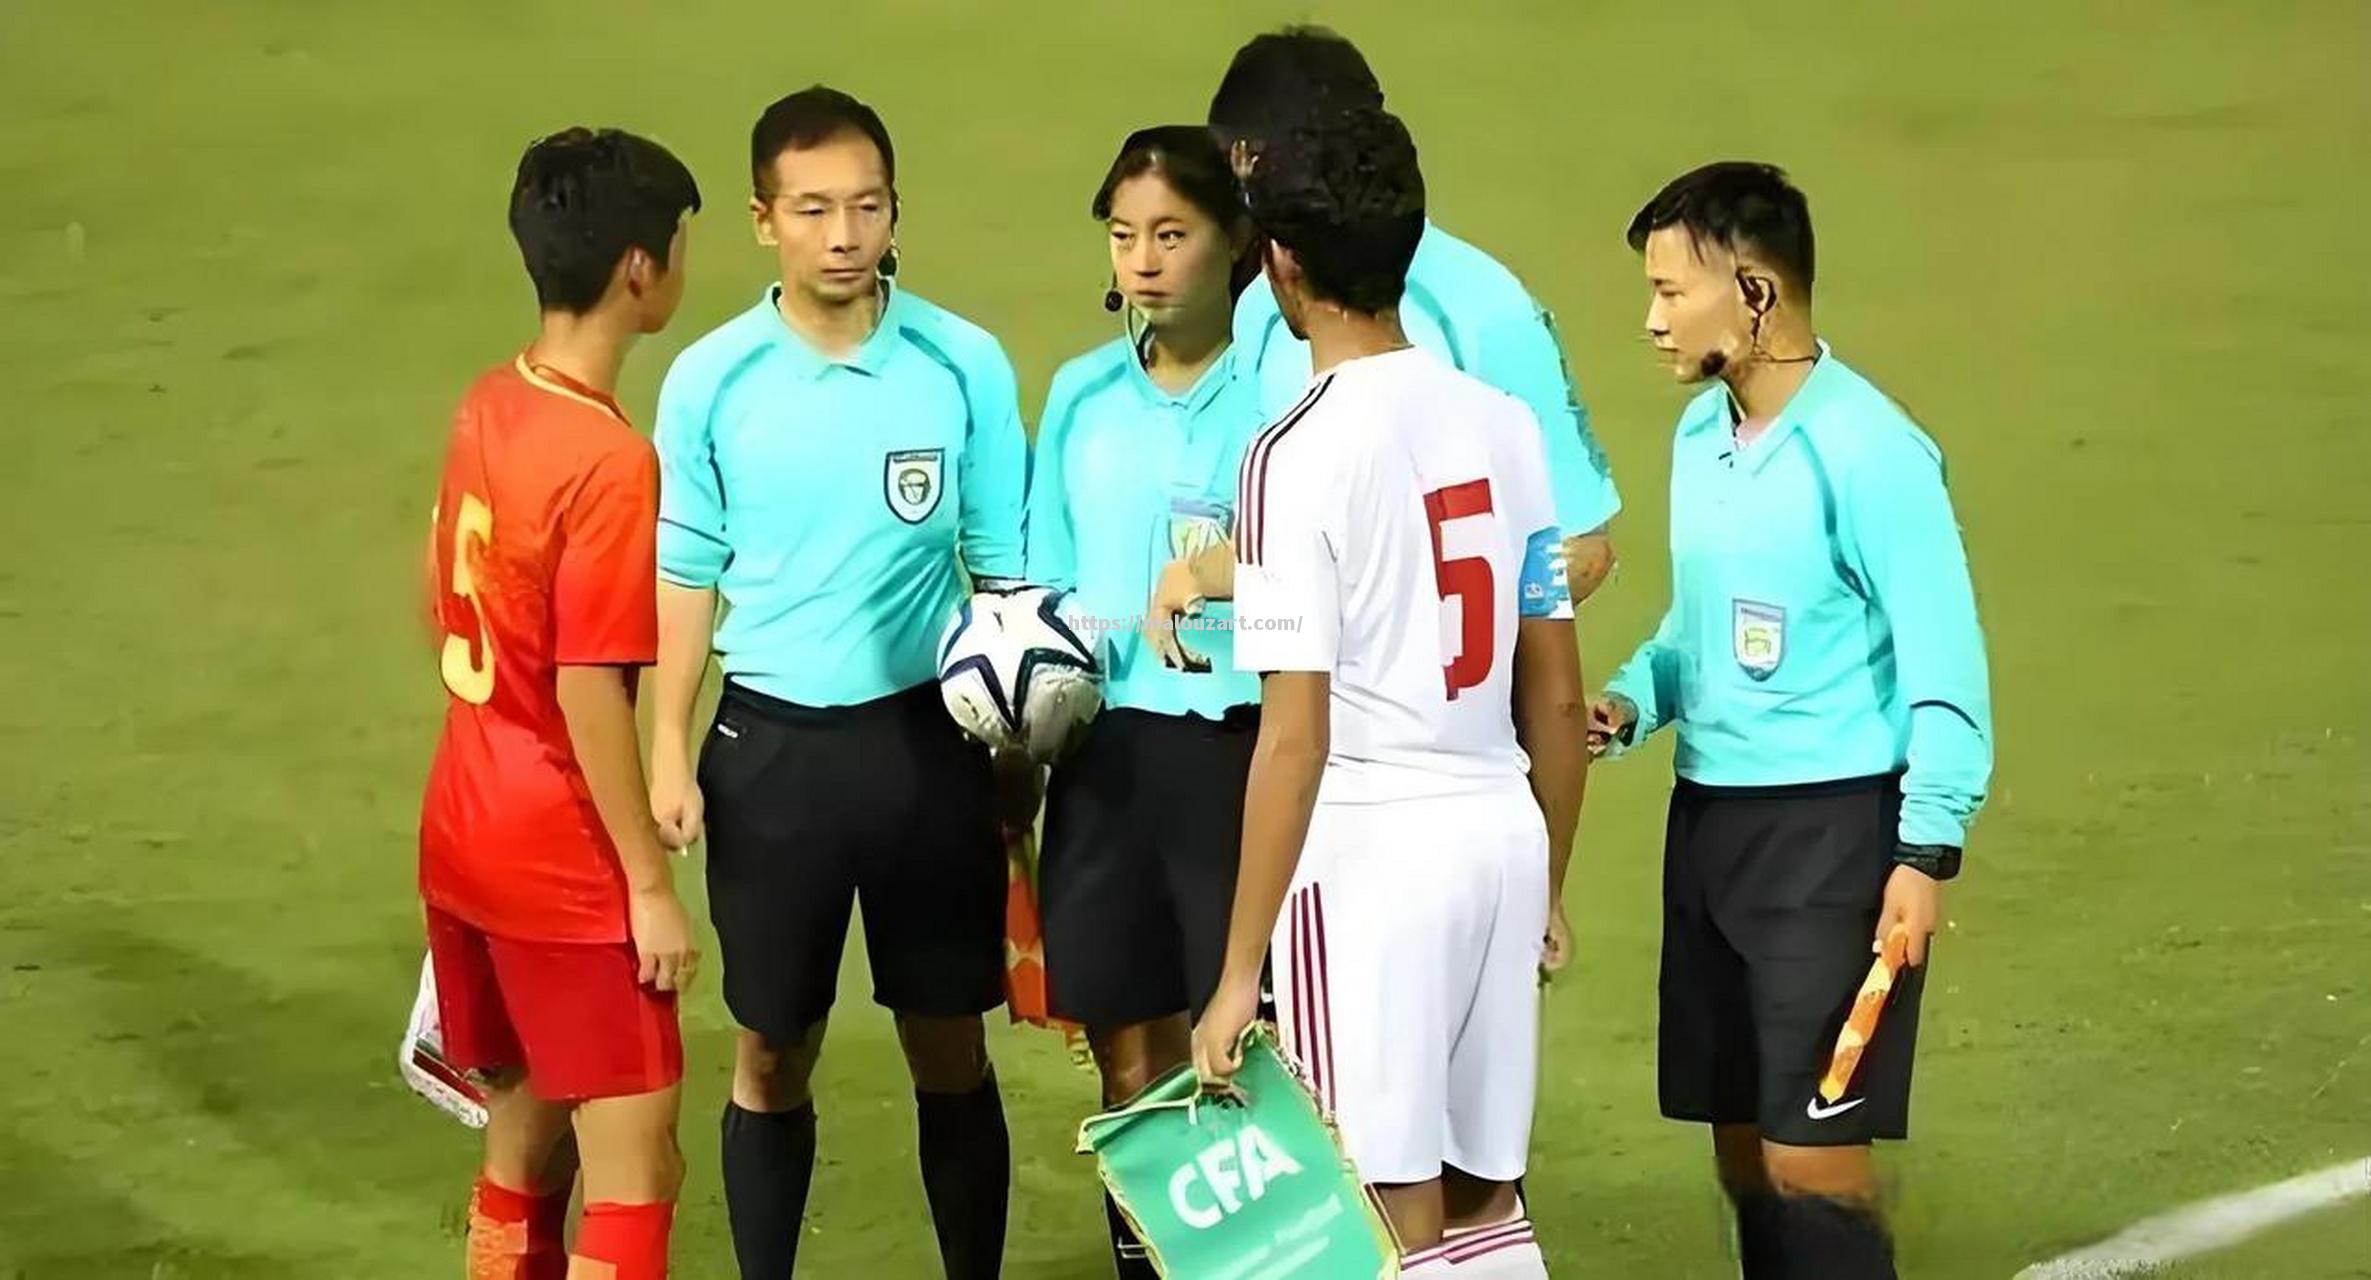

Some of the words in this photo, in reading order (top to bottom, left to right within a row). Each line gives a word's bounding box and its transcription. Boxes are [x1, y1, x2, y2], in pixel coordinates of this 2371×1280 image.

[441, 491, 494, 705] 5
[1423, 478, 1494, 701] 5
[1168, 1124, 1304, 1229] CFA
